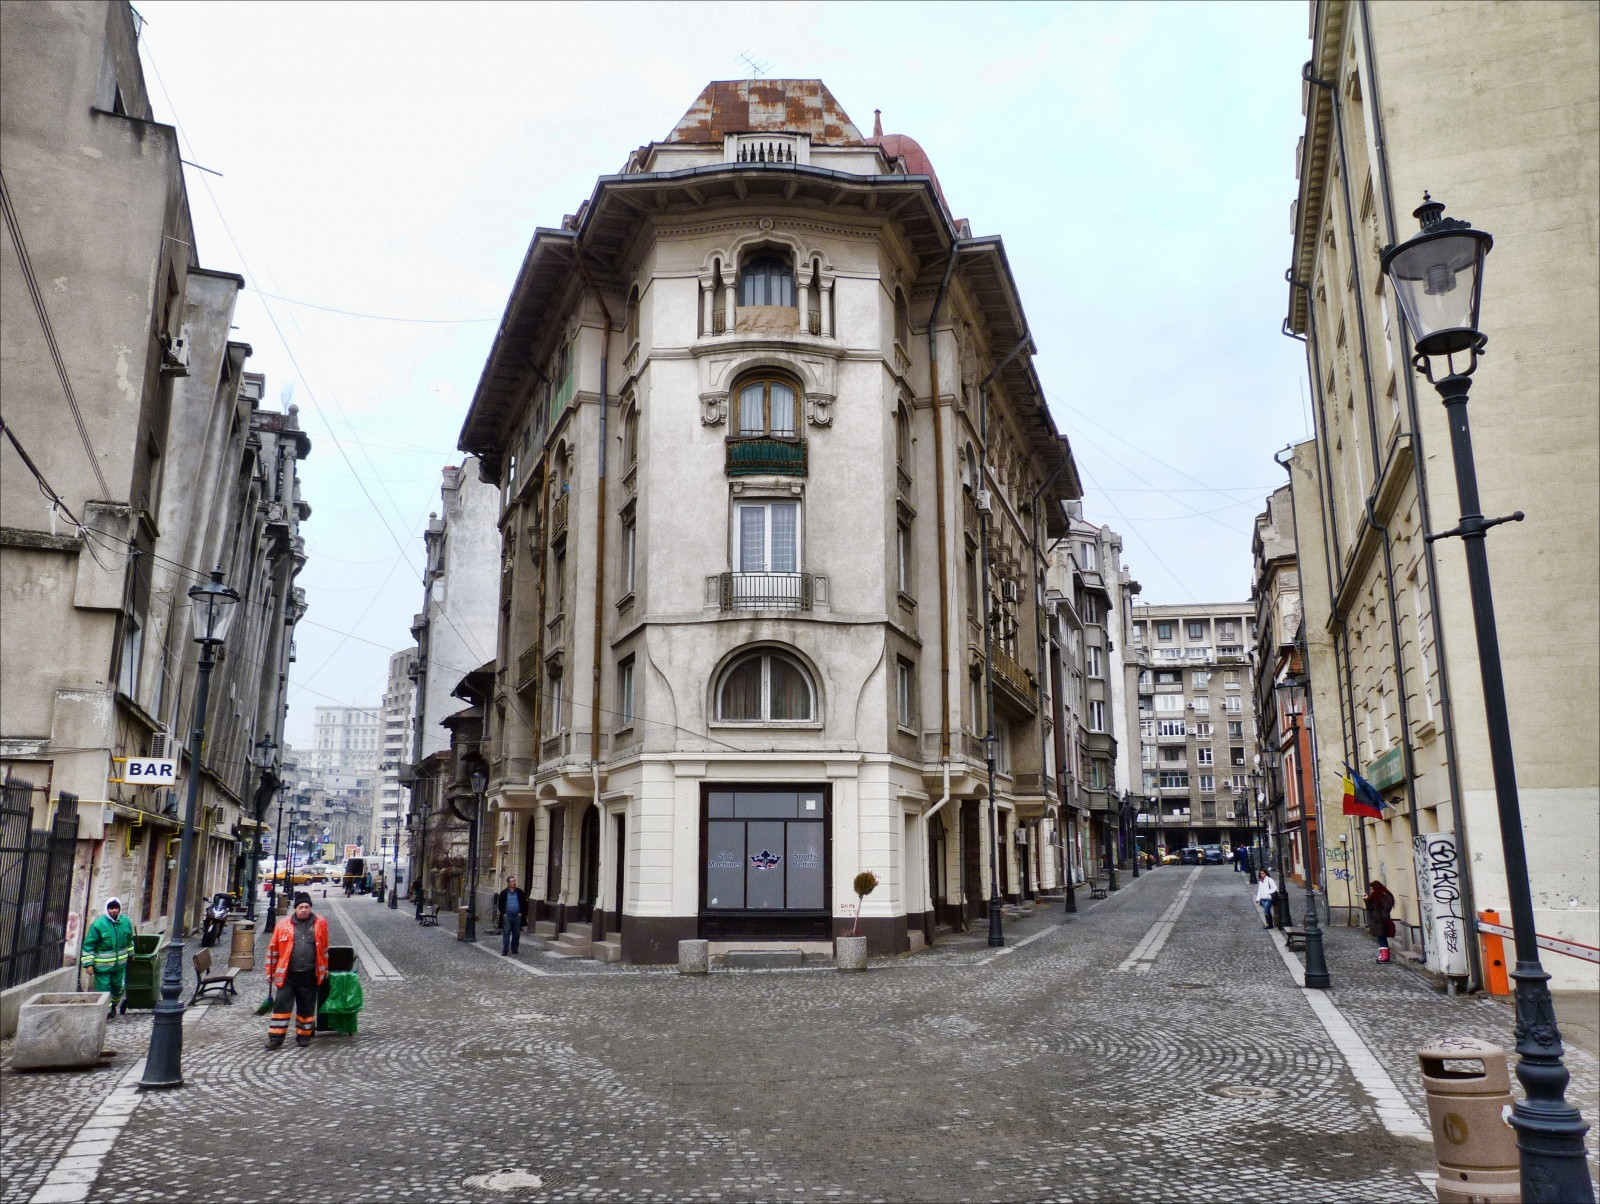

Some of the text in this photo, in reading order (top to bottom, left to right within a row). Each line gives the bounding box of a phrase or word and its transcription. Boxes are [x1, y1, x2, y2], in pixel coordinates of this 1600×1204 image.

[129, 762, 173, 776] BAR
[794, 852, 817, 860] Sports
[708, 860, 742, 868] Machines
[793, 860, 818, 869] Betting
